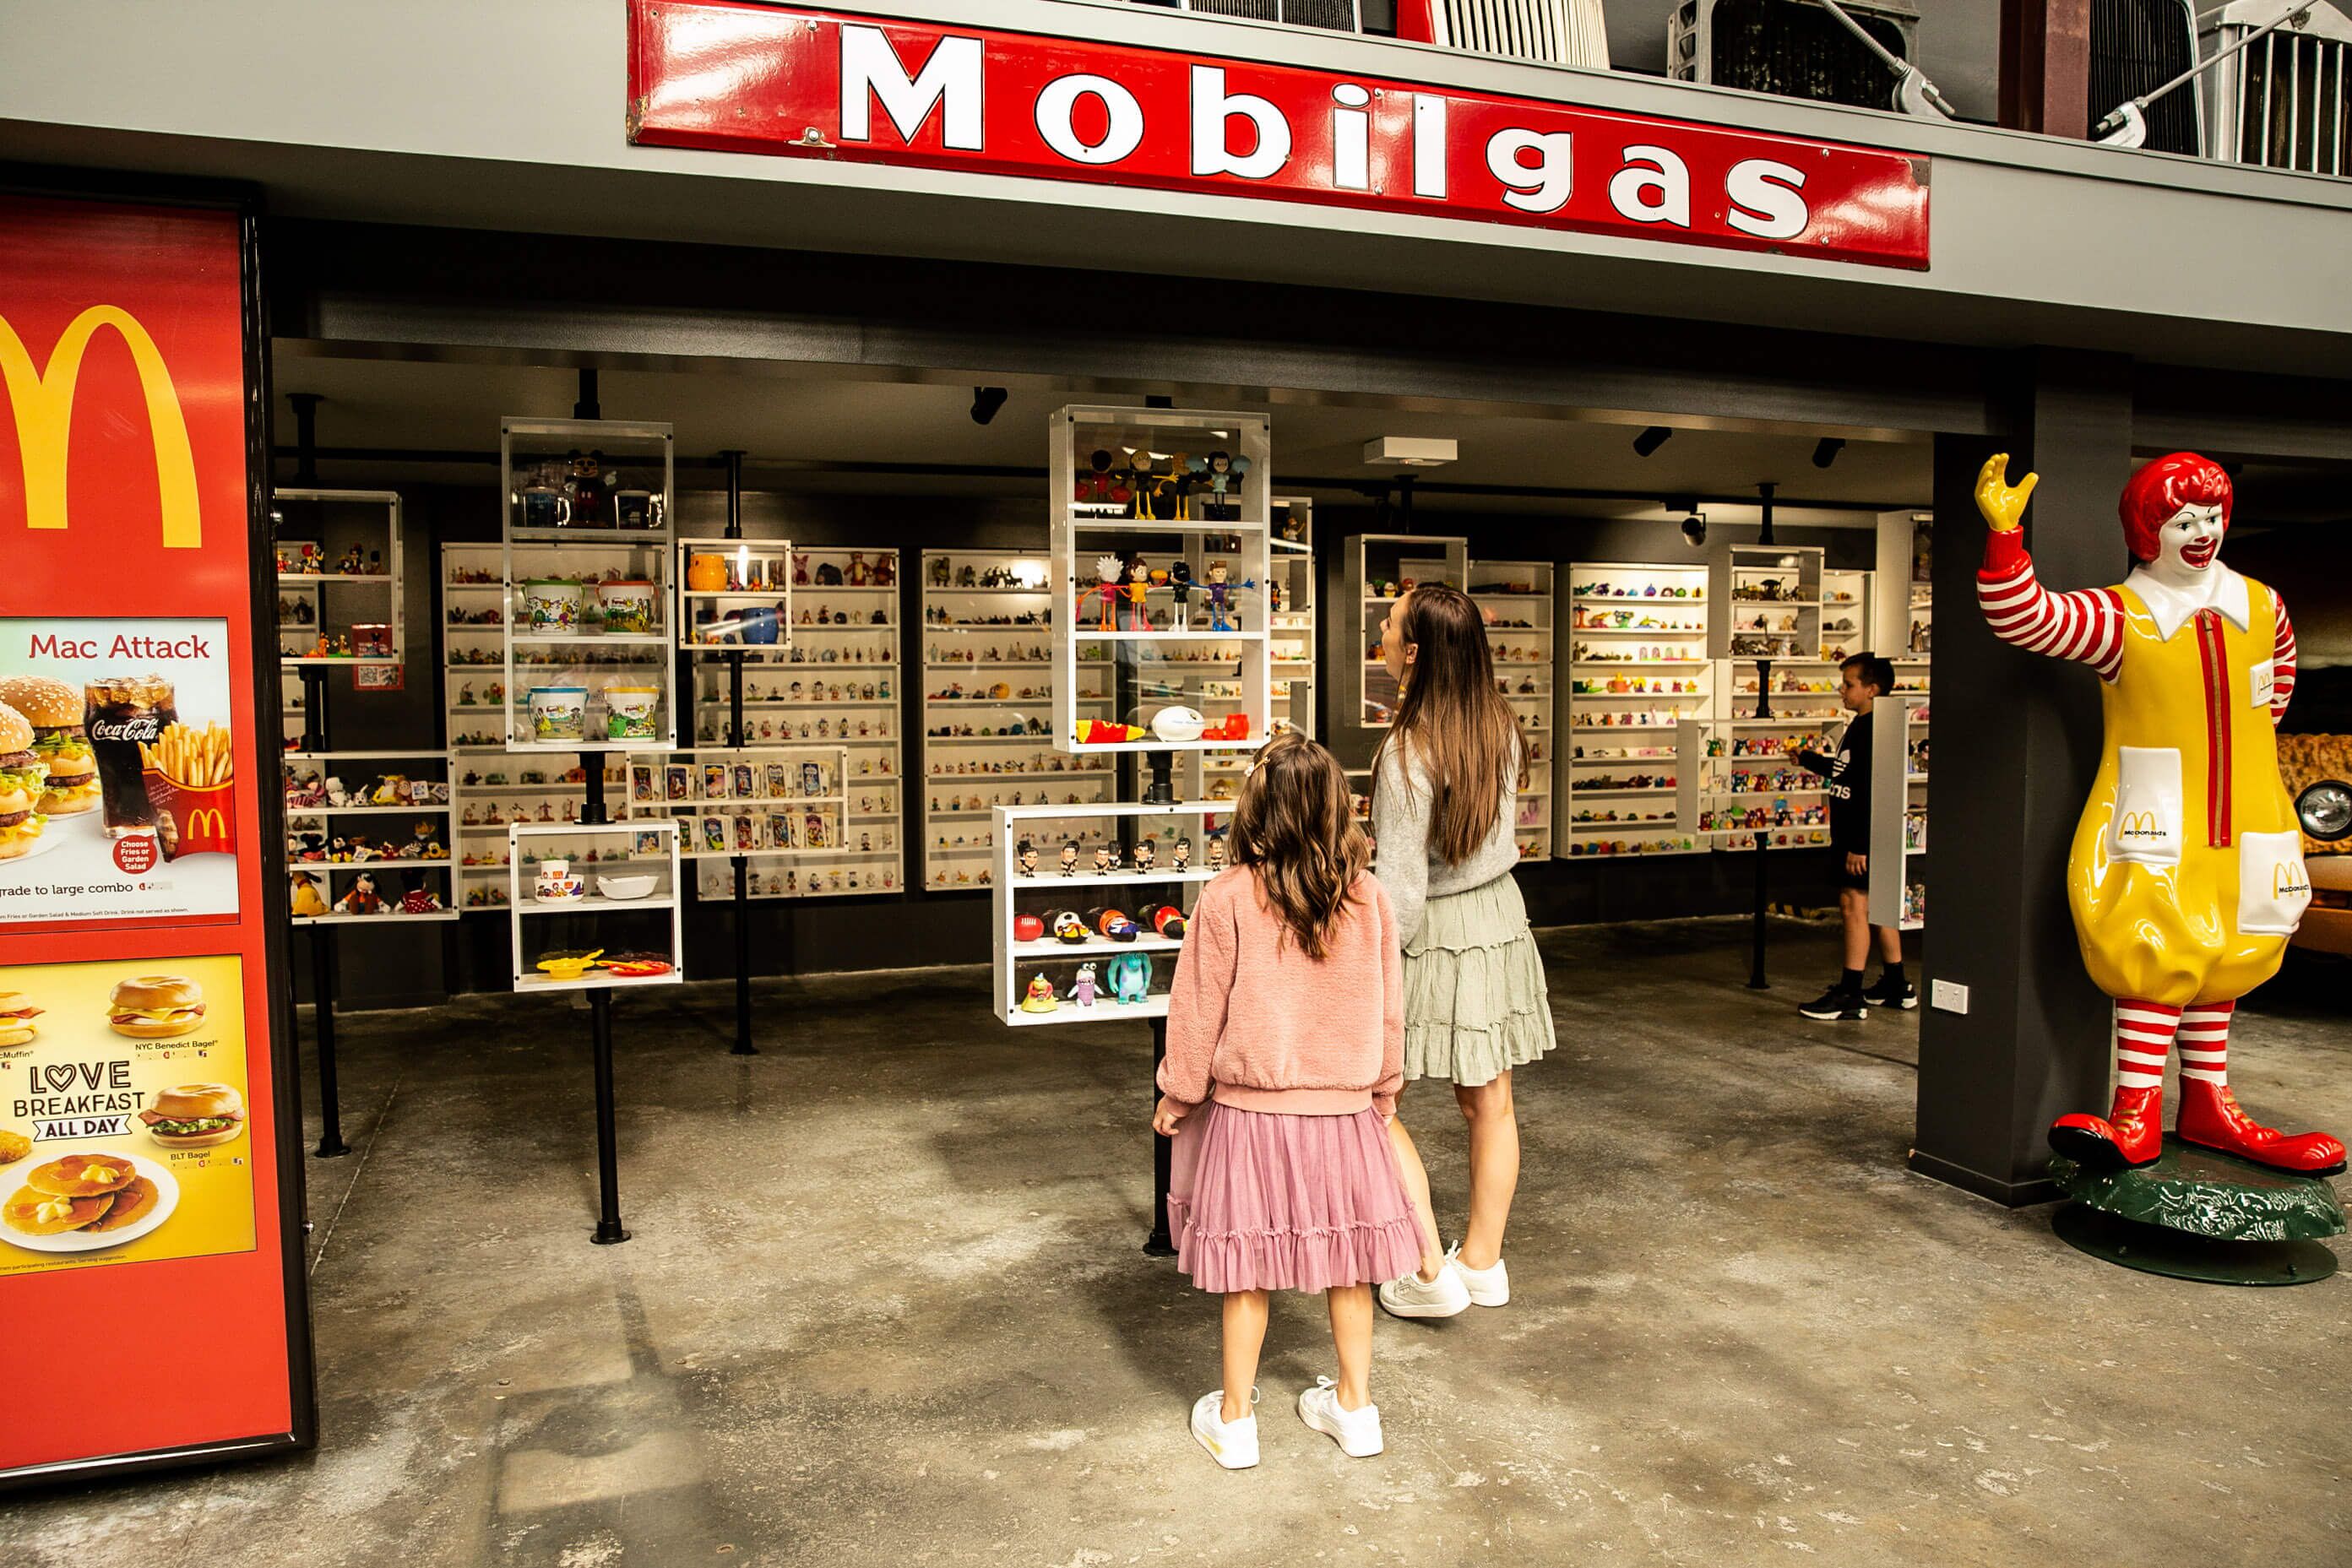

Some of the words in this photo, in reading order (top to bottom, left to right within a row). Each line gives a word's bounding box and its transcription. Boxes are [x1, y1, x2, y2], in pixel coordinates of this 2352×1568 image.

[838, 24, 1812, 240] Mobilgas
[29, 634, 99, 659] Mac
[108, 634, 210, 659] Attack
[35, 887, 48, 895] to
[52, 884, 84, 896] large
[88, 882, 133, 893] combo
[155, 1041, 190, 1050] Benedict
[14, 1092, 146, 1118] BREAKFAST
[45, 1124, 78, 1138] ALL
[84, 1119, 120, 1134] DAY
[187, 1151, 210, 1160] Bagel
